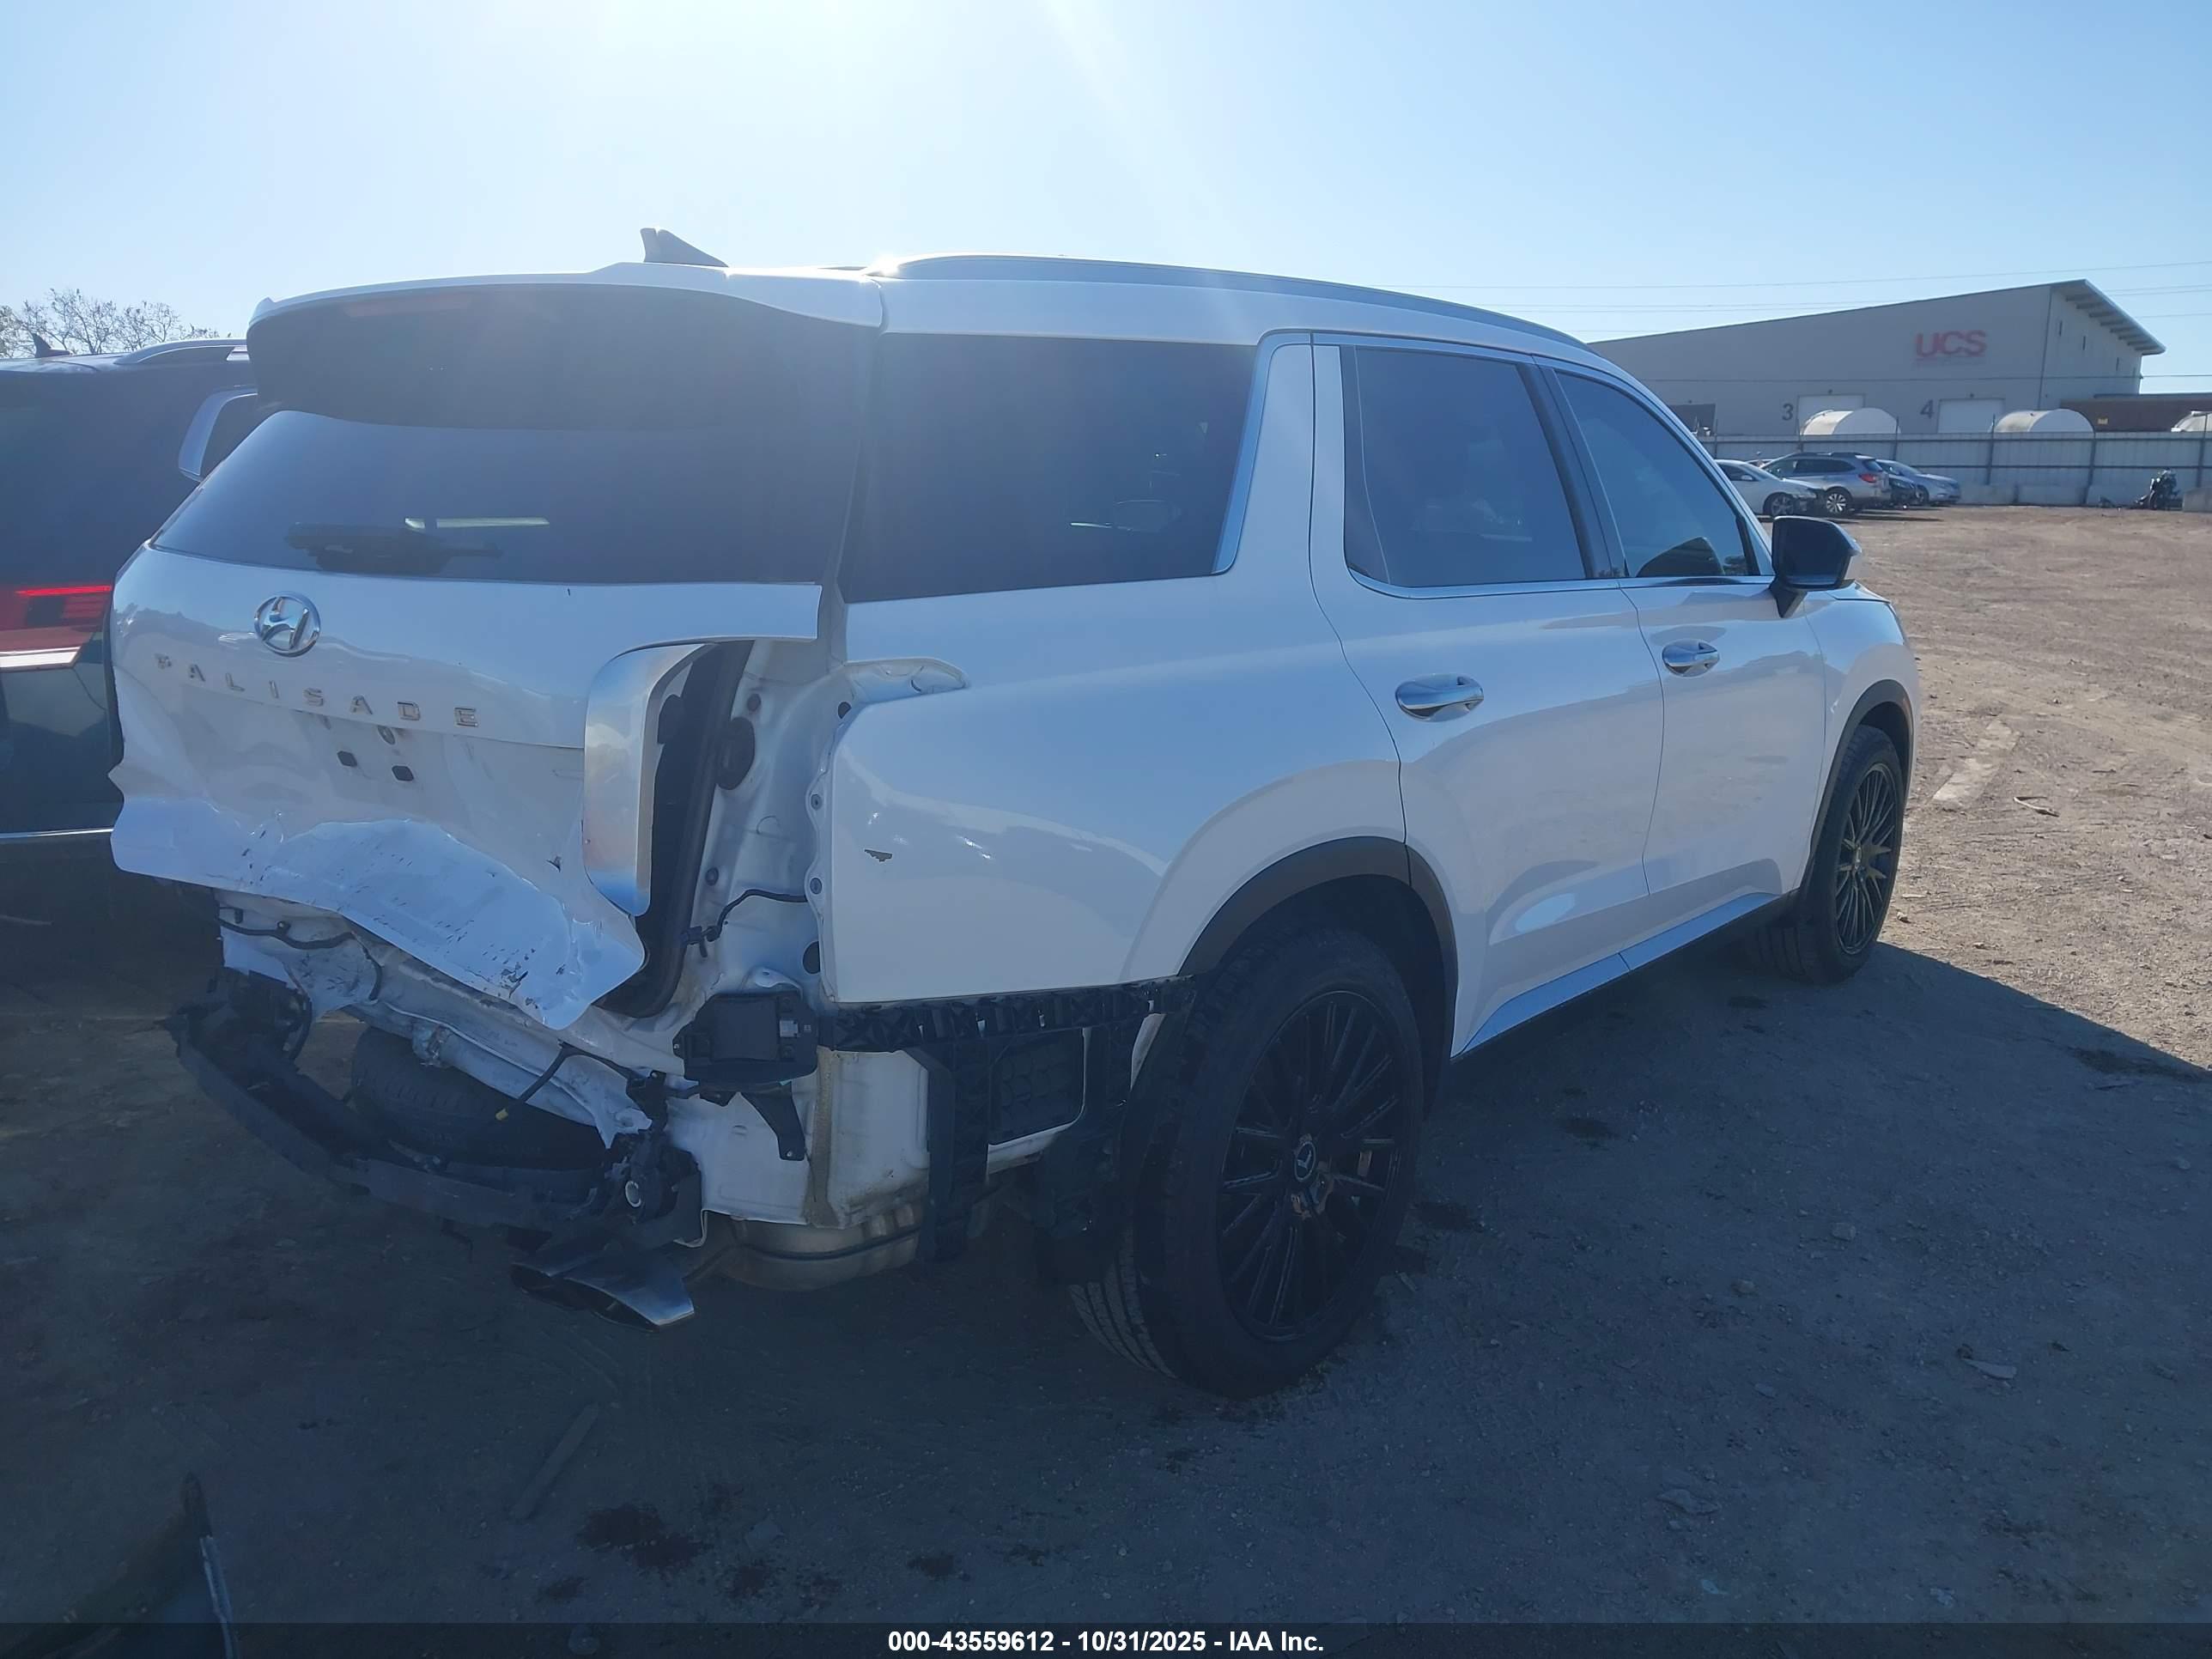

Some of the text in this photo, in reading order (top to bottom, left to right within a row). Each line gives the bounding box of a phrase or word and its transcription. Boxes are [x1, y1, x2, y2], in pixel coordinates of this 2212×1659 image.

[1916, 330, 1987, 357] UCS
[1782, 403, 1794, 421] 3
[1920, 399, 1934, 418] 4
[155, 653, 479, 728] PALISADE
